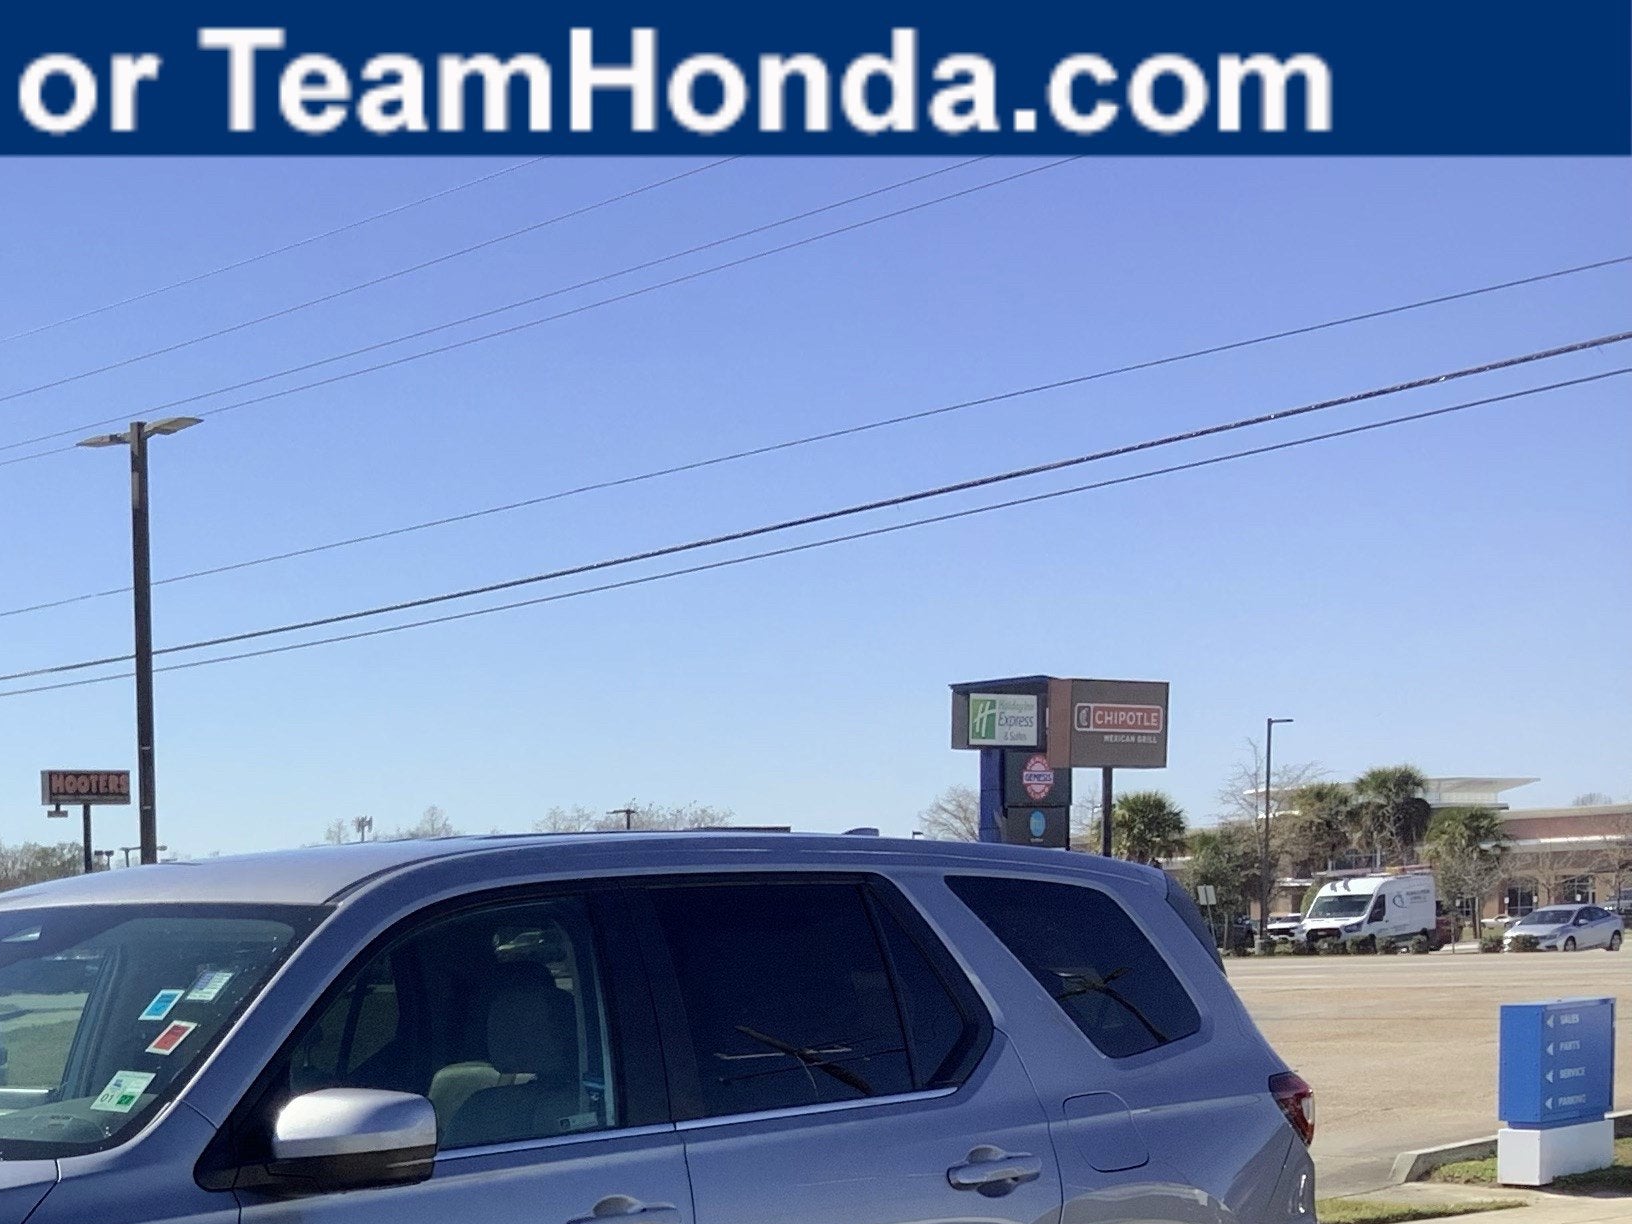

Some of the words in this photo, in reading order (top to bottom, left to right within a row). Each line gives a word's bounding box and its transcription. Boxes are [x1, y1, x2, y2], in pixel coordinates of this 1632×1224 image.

[998, 711, 1035, 730] Express
[1094, 710, 1159, 727] CHIPOTLE
[1103, 734, 1136, 743] MEXICAN
[1136, 735, 1158, 744] GRILL
[51, 774, 128, 794] HOOTERS
[1024, 773, 1052, 782] GENESIS
[1559, 1041, 1581, 1051] PARTS
